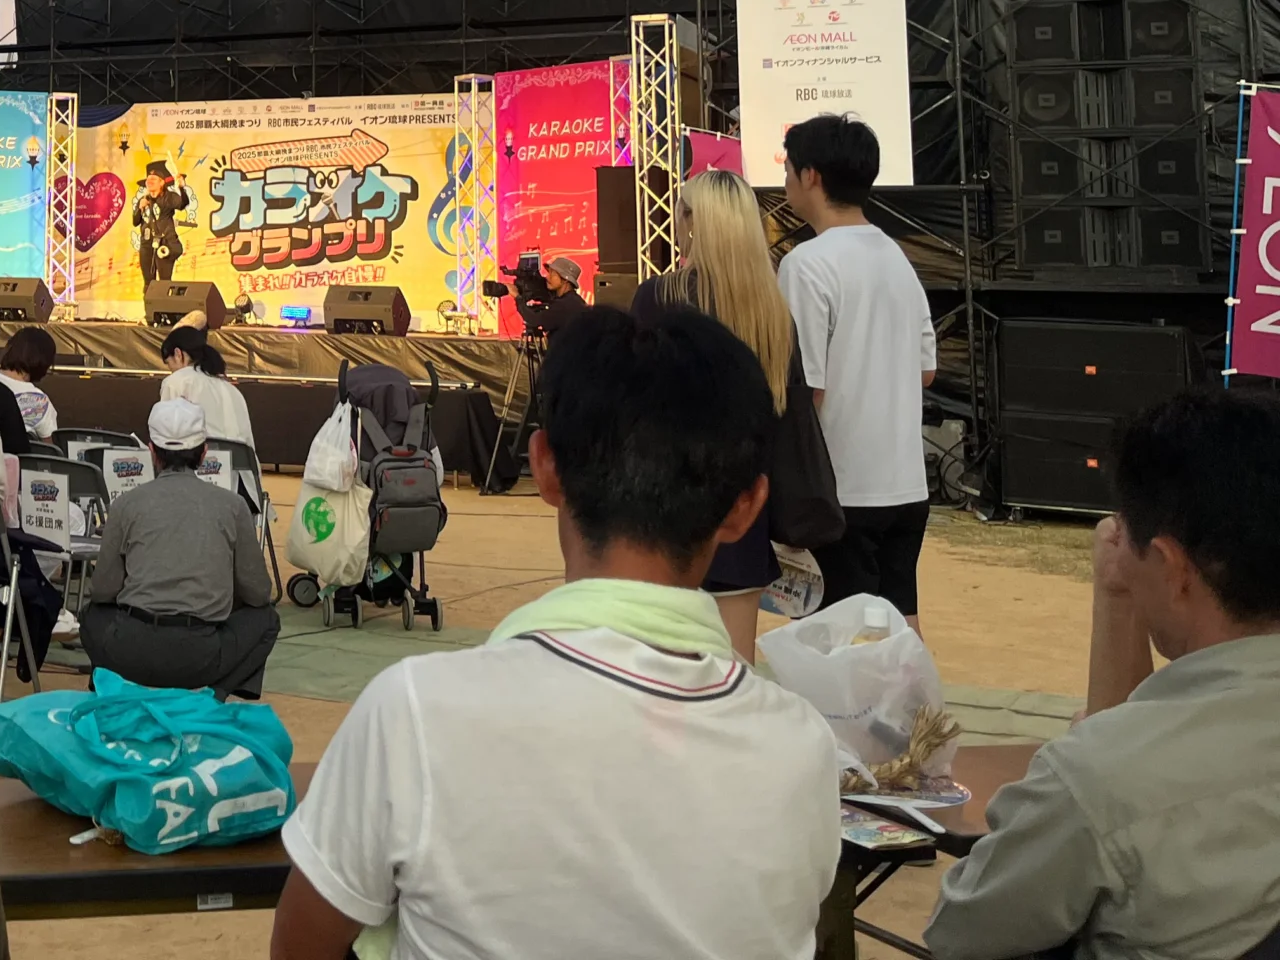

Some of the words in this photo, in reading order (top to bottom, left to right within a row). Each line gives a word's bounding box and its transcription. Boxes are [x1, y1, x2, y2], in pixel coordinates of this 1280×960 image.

[821, 31, 857, 43] MALL
[774, 55, 882, 67] イオンフィナンシャルサービス
[796, 88, 818, 101] RBC
[527, 117, 605, 138] KARAOKE
[517, 143, 570, 161] GRAND
[574, 140, 611, 157] PRIX
[210, 165, 419, 232] カラオケ
[230, 218, 388, 266] グランプリ
[25, 514, 64, 530] 応援団席
